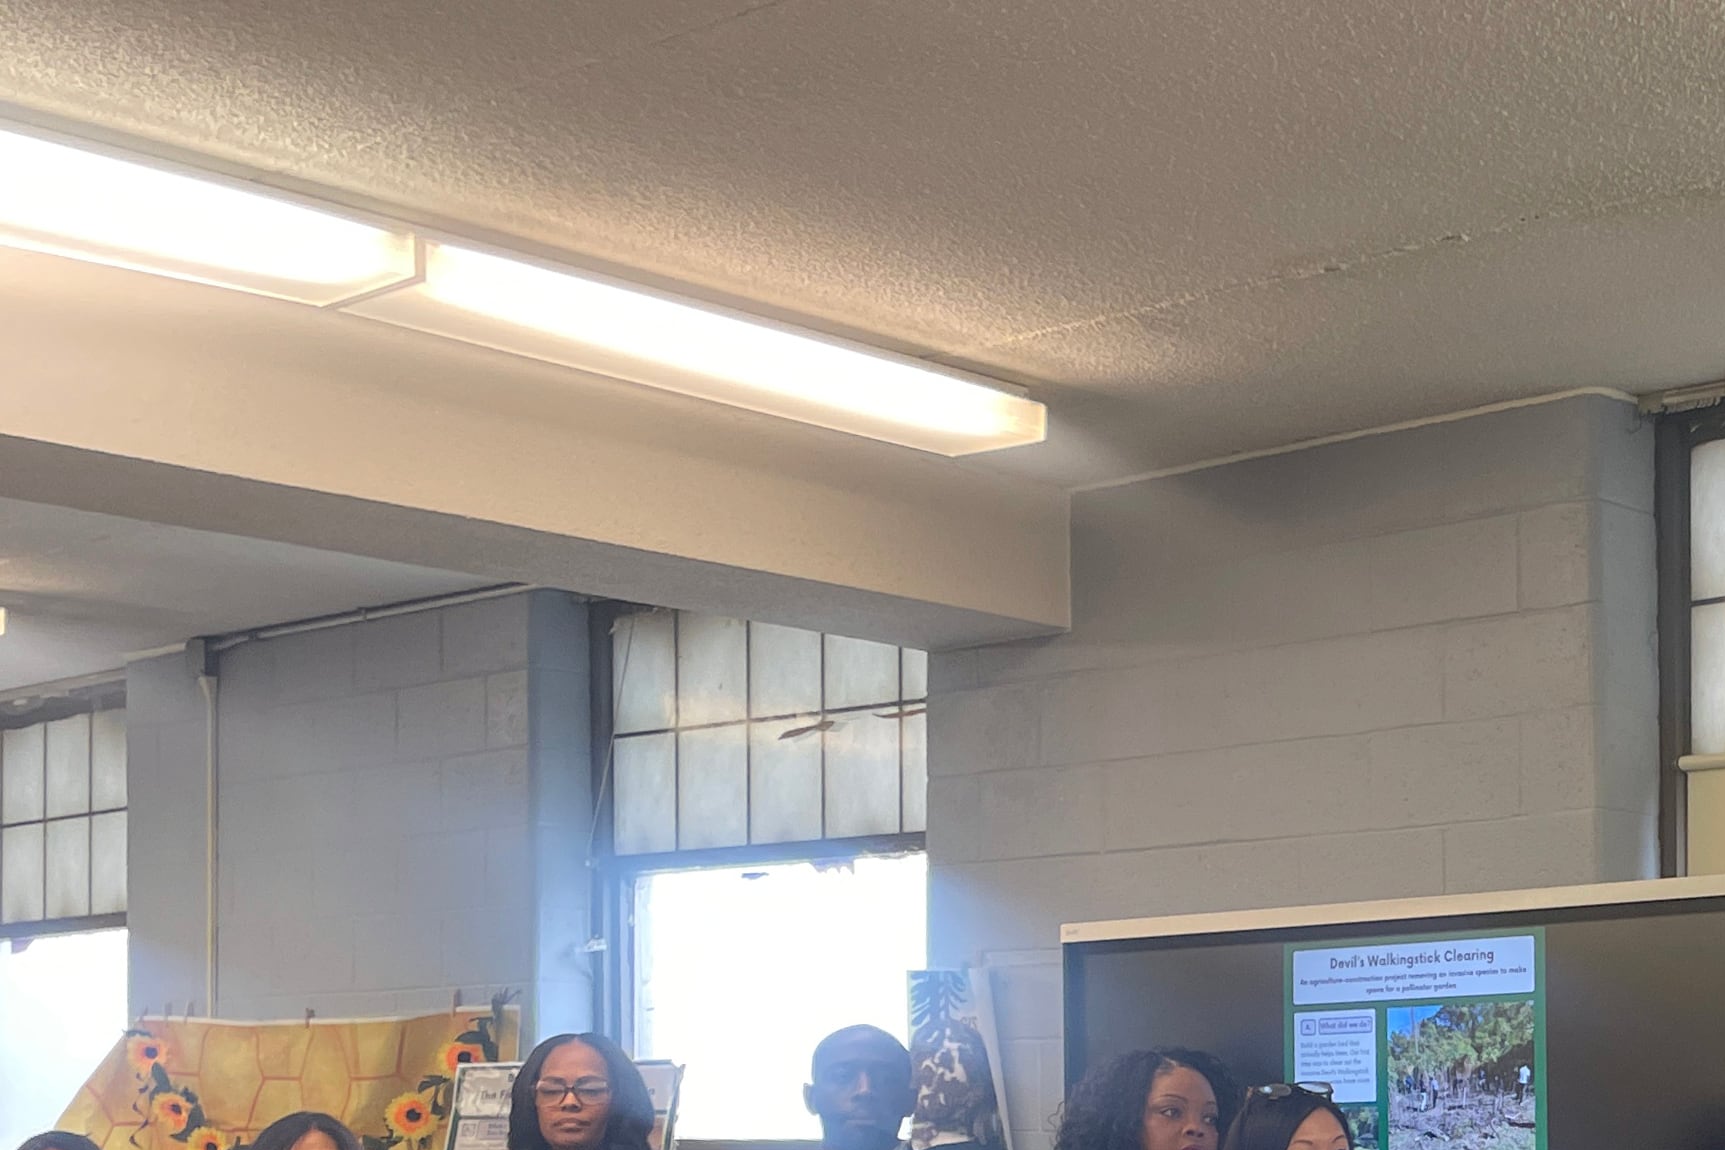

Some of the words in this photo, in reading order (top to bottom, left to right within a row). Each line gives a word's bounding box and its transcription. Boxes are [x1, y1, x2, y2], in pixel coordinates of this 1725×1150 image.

[1330, 953, 1365, 969] Devil's
[1367, 950, 1441, 970] Walkingstick
[1444, 949, 1494, 963] Clearing
